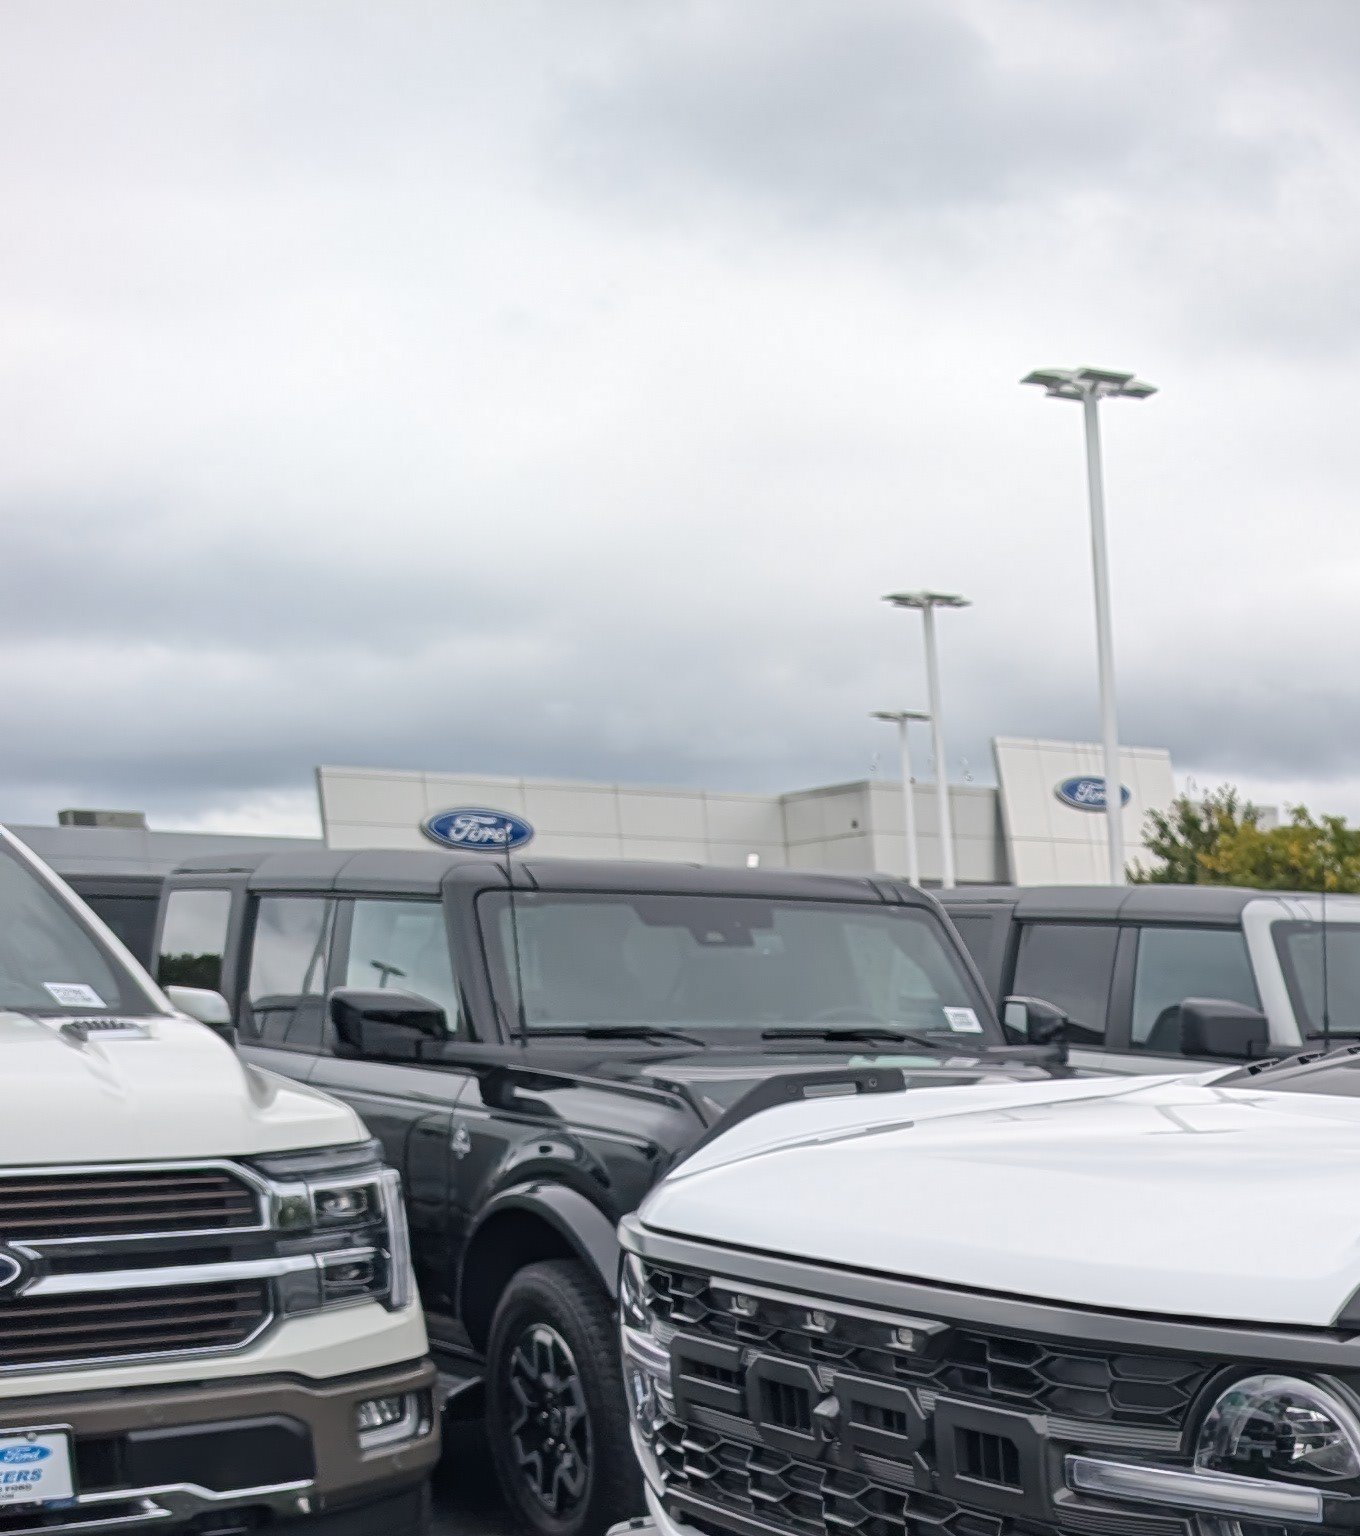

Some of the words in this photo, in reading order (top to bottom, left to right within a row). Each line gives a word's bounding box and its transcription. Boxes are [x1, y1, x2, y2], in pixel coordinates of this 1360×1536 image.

[448, 813, 513, 842] Ford
[669, 1332, 1050, 1520] FORD
[3, 1446, 40, 1461] Ford
